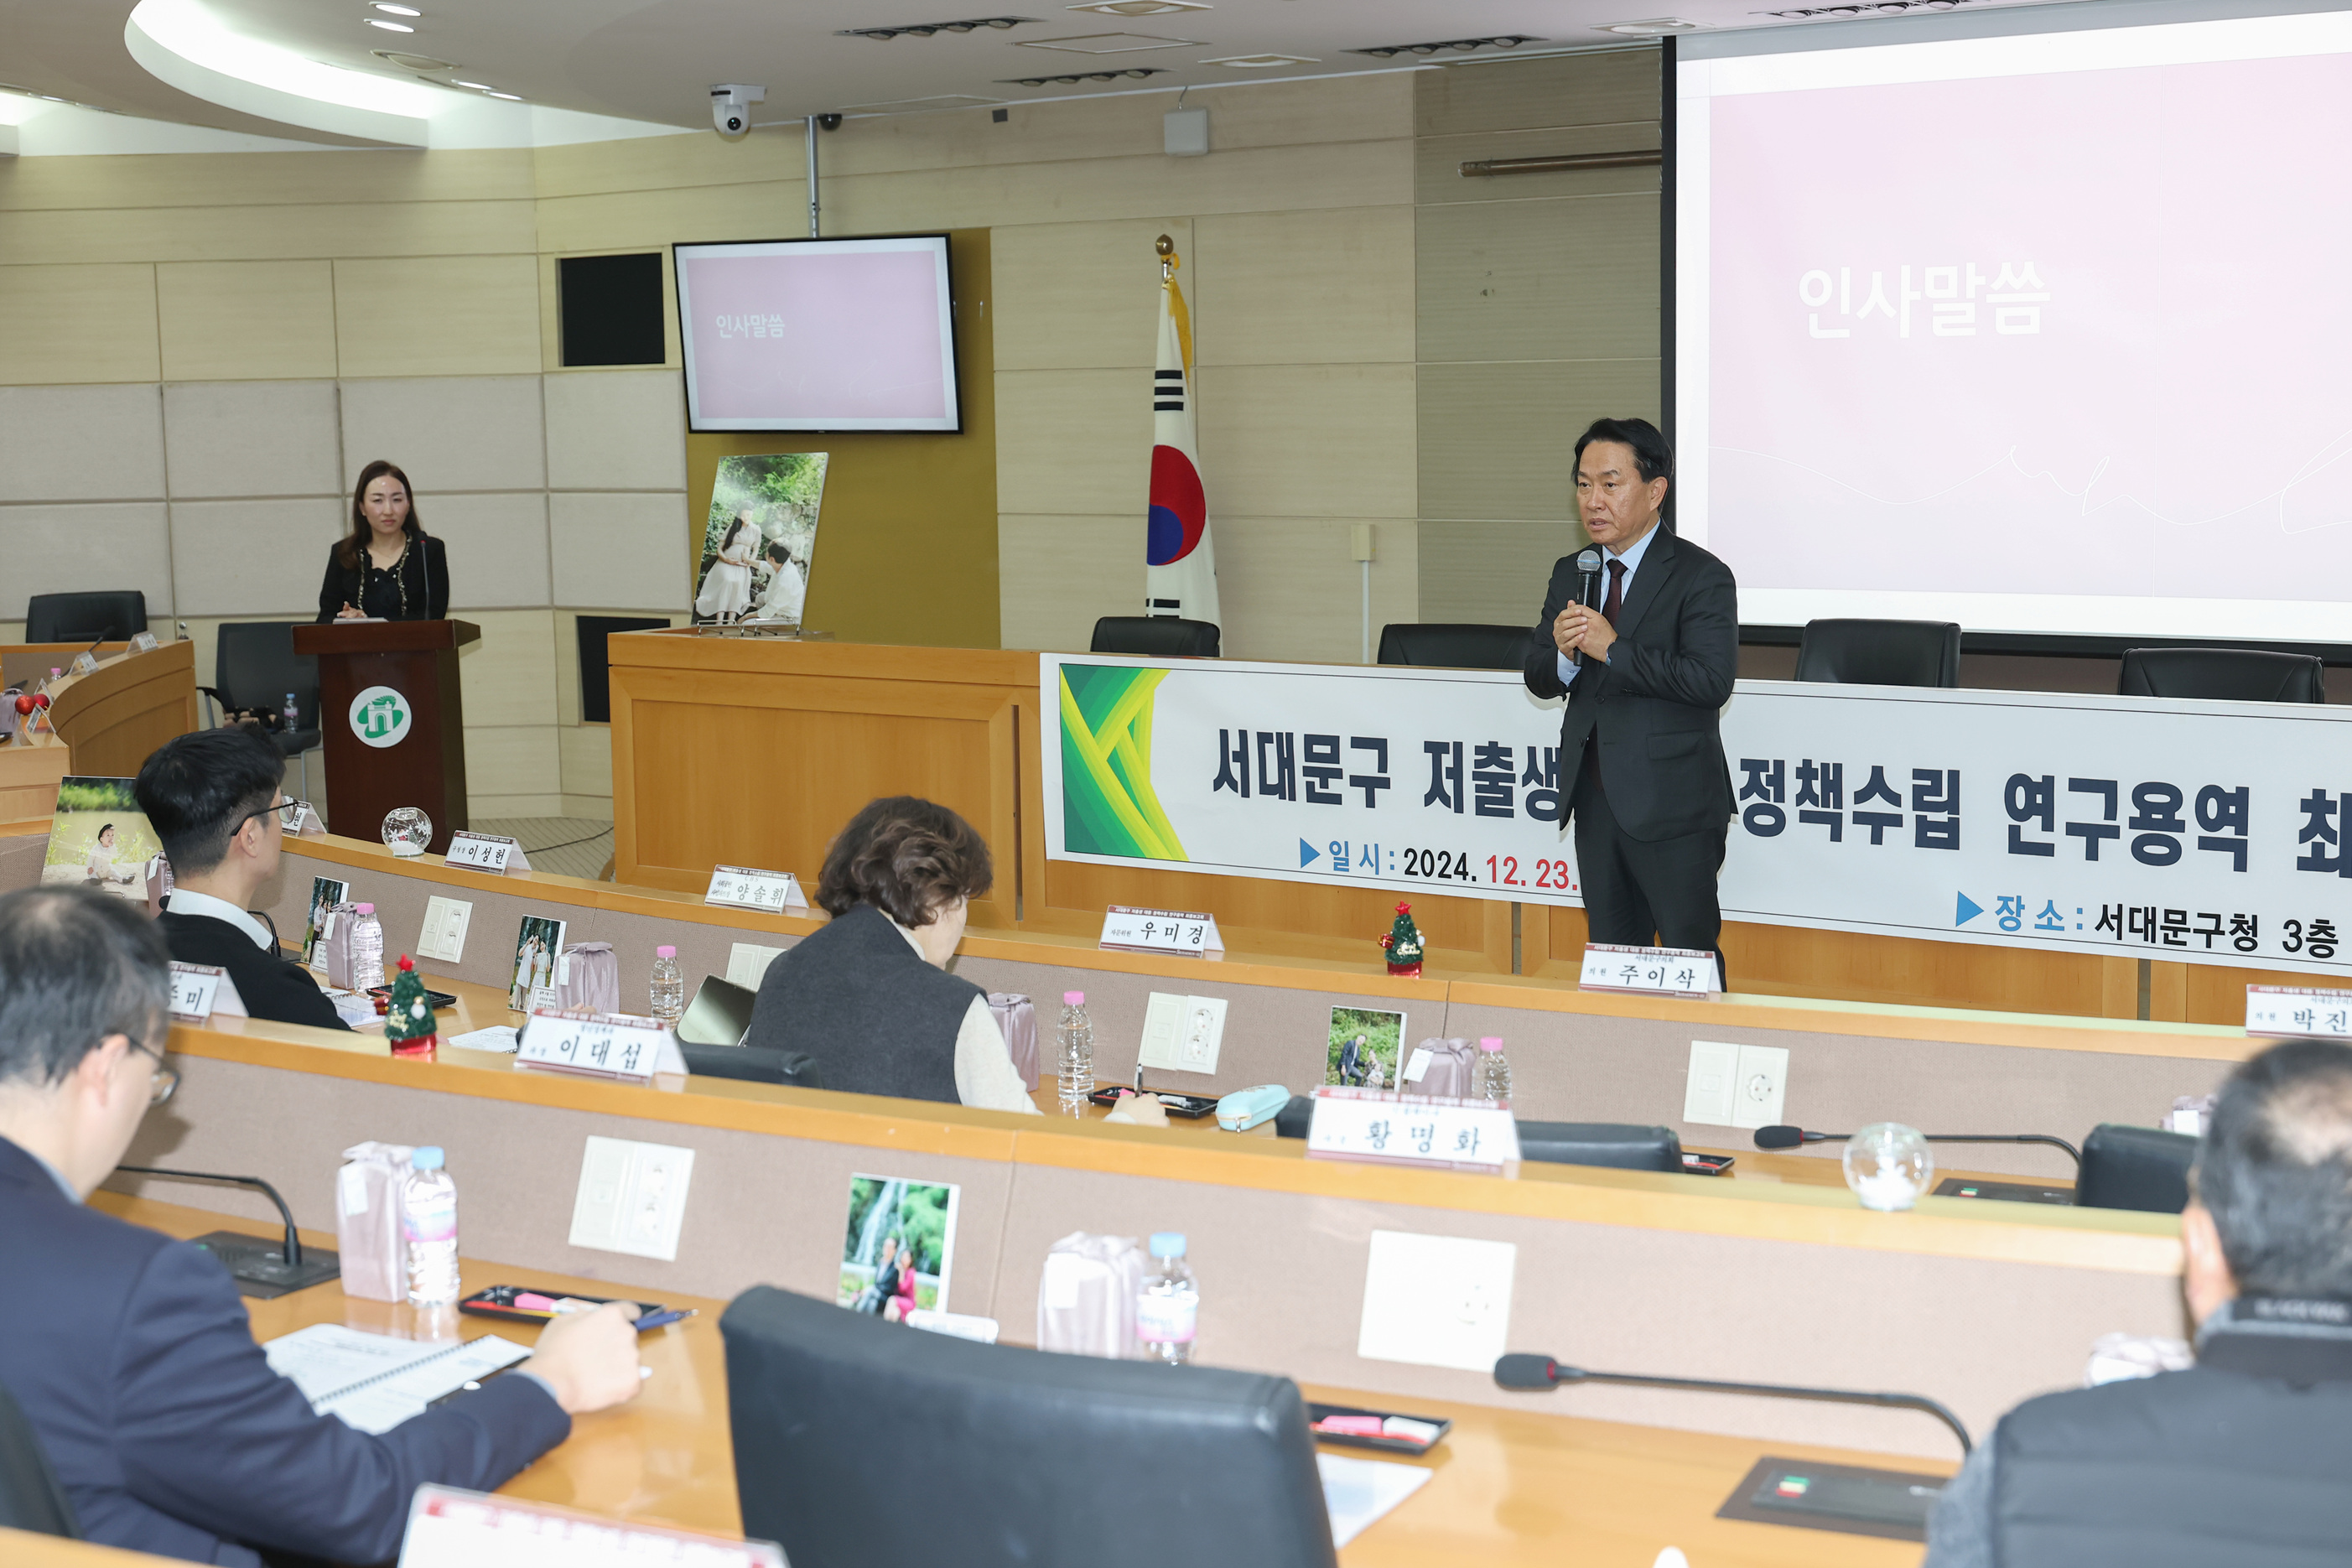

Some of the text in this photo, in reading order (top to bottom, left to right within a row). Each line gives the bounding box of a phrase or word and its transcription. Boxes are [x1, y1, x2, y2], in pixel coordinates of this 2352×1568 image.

[1798, 260, 2051, 340] 인사말씀
[715, 314, 786, 339] 인사말씀
[1212, 728, 2352, 880] 서대문구 저출생 정책수립 연구용역 최
[1403, 847, 1477, 883] 2024.
[1140, 921, 1204, 945] 우미경
[2095, 903, 2260, 953] 서대문구청
[2282, 918, 2339, 959] 3층
[1618, 964, 1696, 989] 주이삭
[2292, 1007, 2347, 1033] 박진
[559, 1035, 642, 1070] 이대섭
[1365, 1119, 1482, 1157] 황명화
